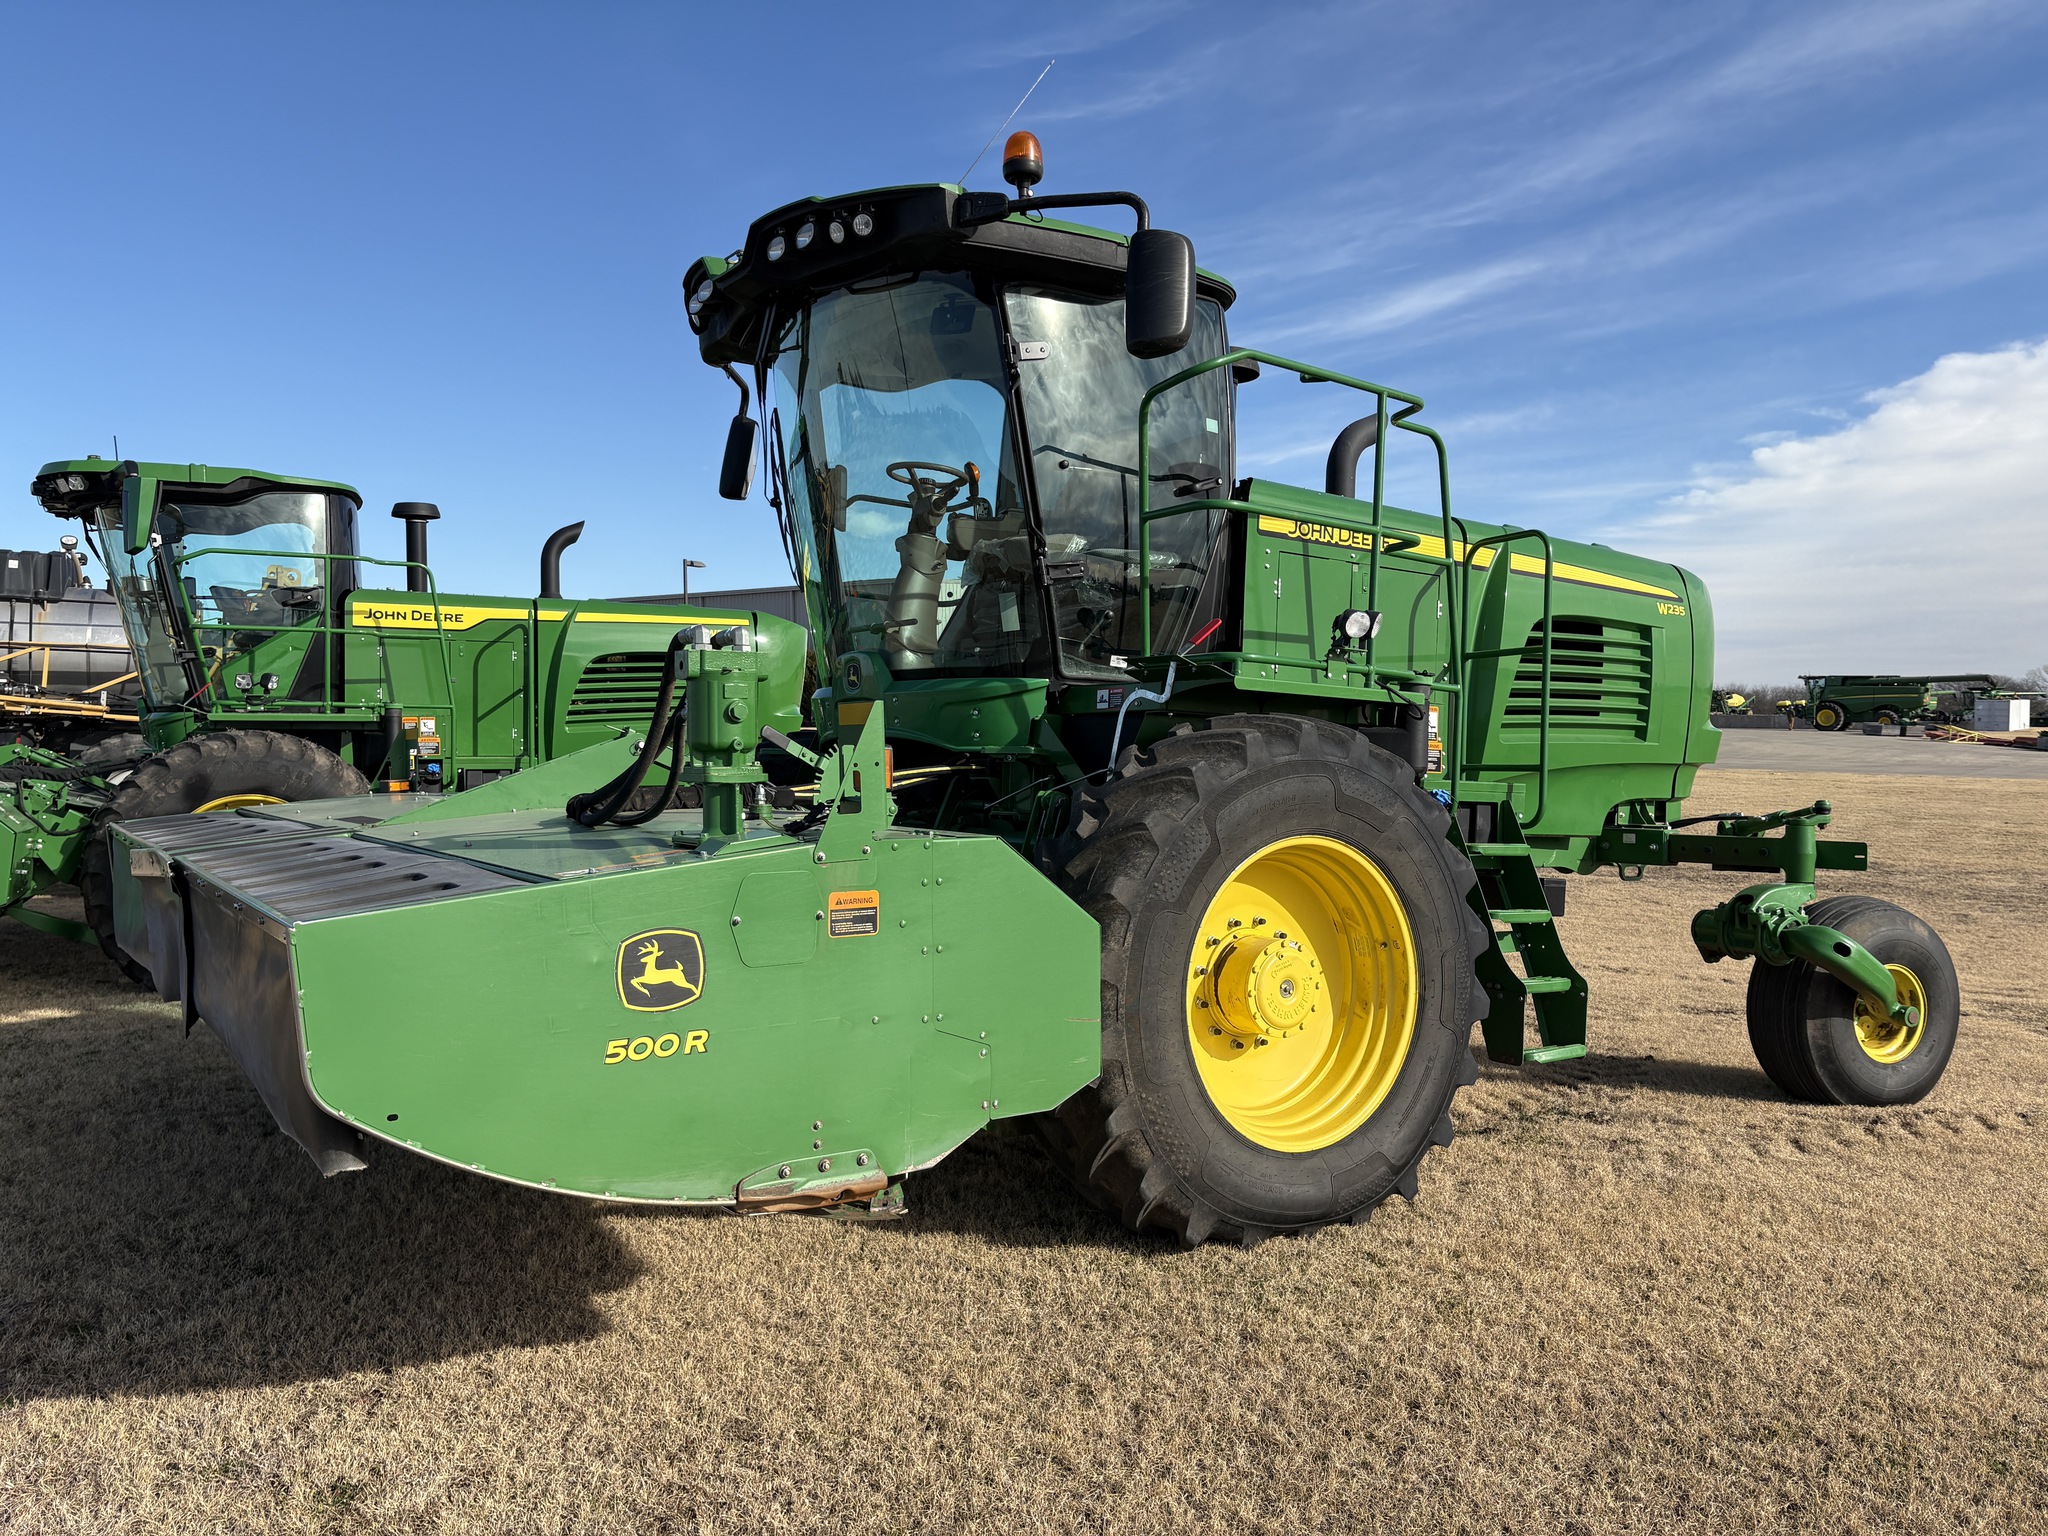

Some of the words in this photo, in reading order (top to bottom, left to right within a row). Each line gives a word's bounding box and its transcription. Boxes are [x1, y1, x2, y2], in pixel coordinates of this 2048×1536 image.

[1288, 520, 1335, 541] JOHN
[1338, 528, 1393, 550] DEEE
[364, 608, 407, 621] JOHN
[411, 610, 464, 623] DEERE
[1656, 601, 1686, 617] W235
[842, 896, 874, 905] WARNING
